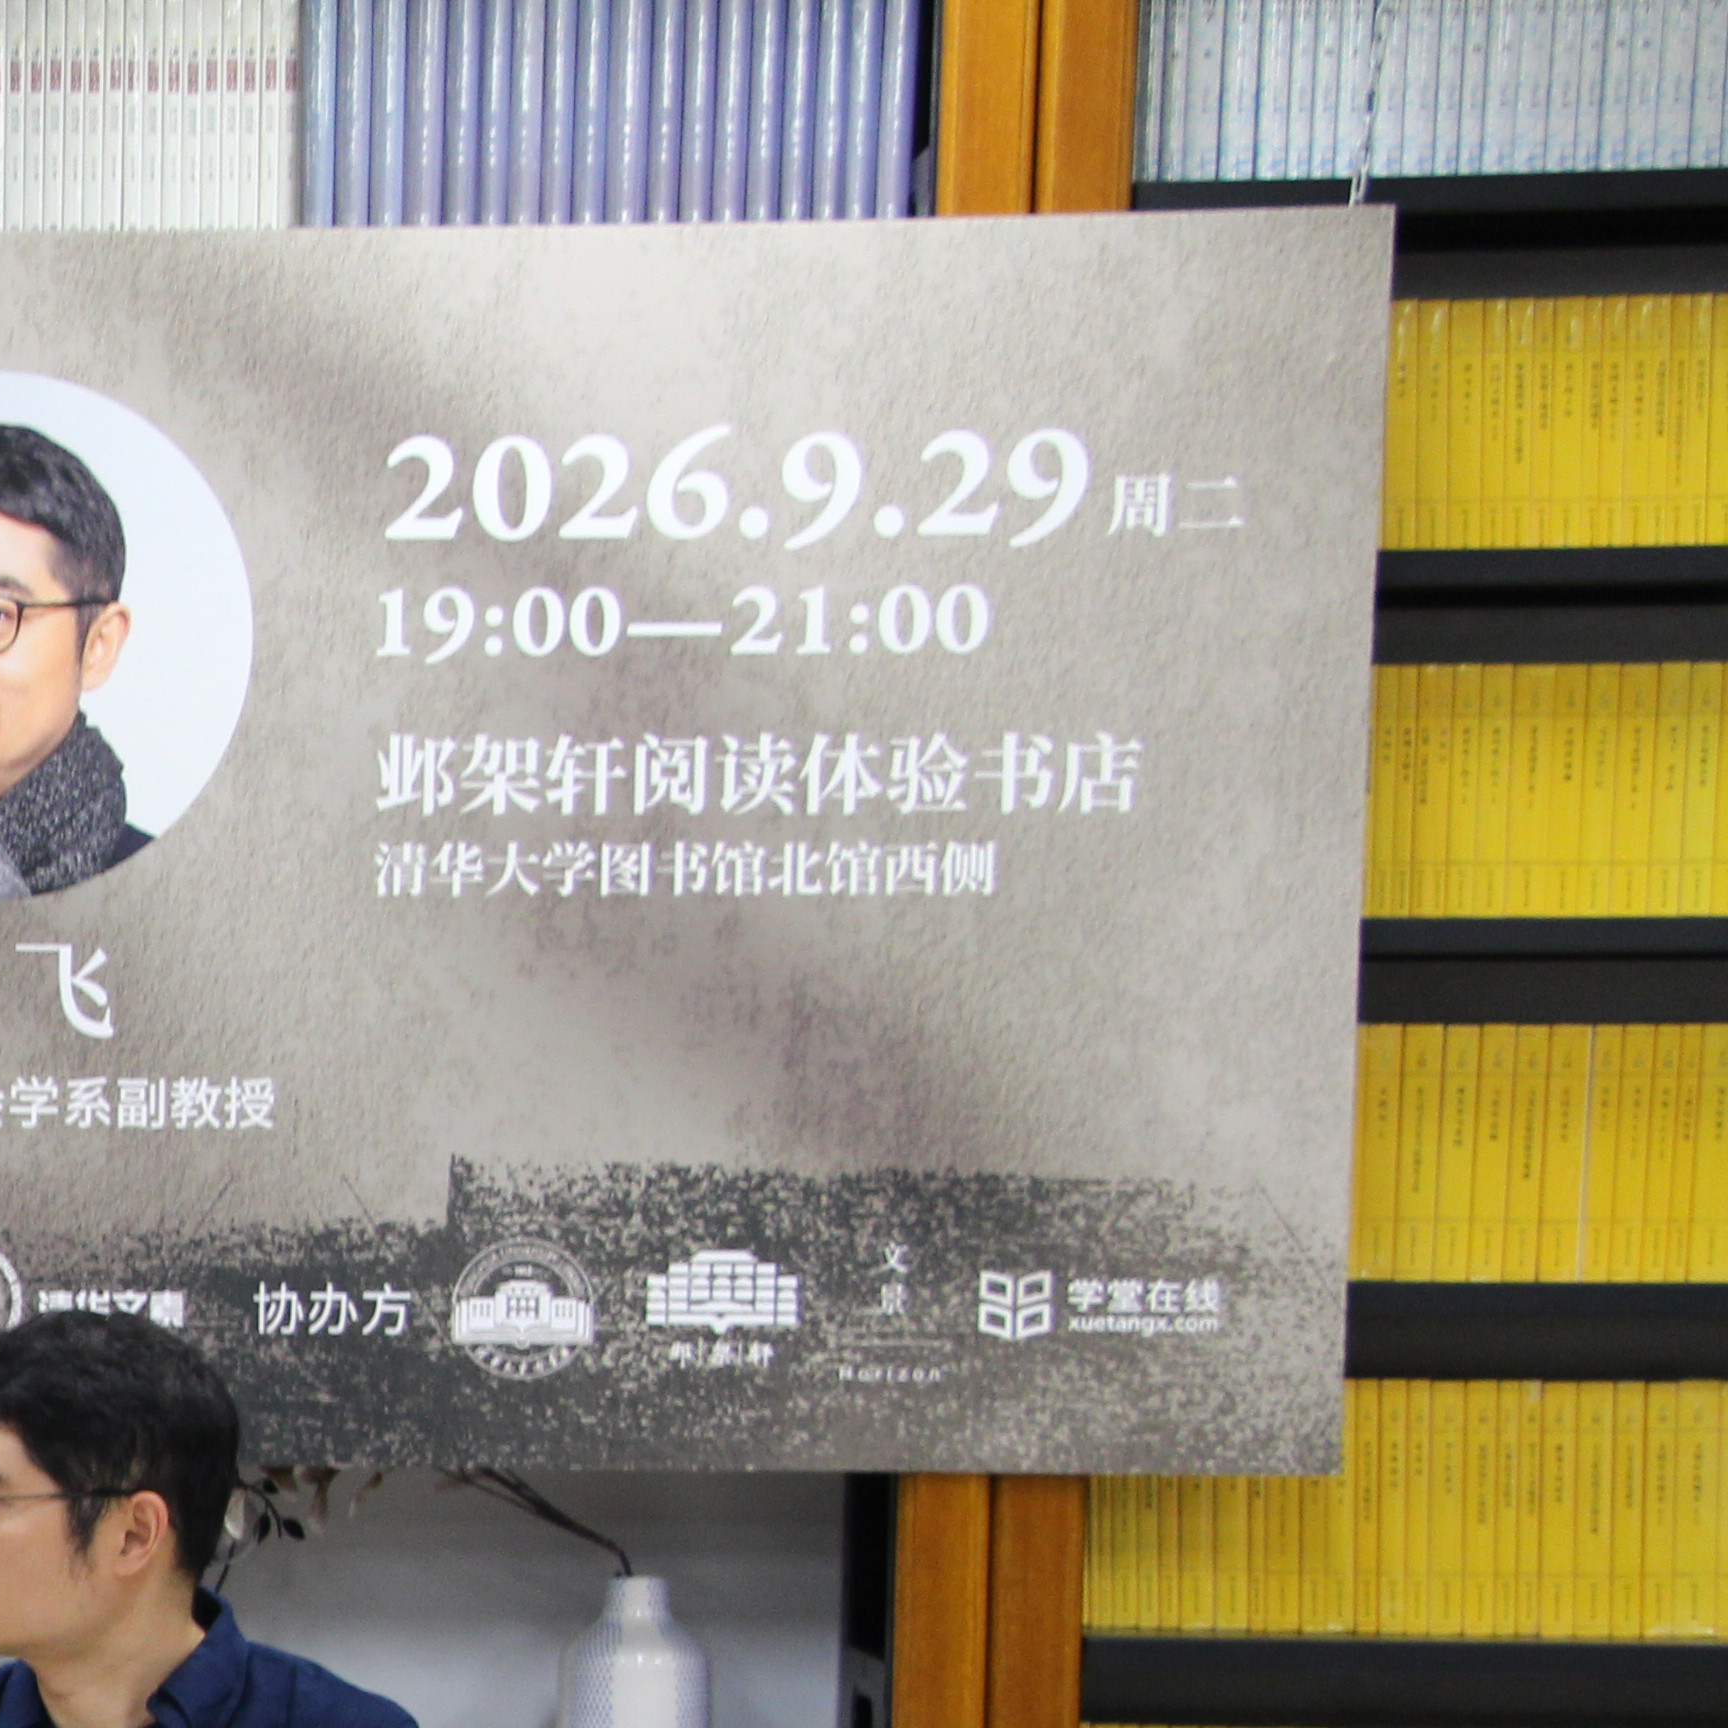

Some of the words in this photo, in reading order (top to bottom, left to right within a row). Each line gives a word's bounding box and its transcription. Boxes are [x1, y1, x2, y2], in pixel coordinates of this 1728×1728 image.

[384, 422, 1091, 550] 2026.9.29
[1107, 471, 1246, 538] 周二
[374, 731, 1144, 817] 邺架轩阅读体验书店
[373, 840, 998, 899] 清华大学图书馆北馆西侧
[252, 1280, 414, 1337] 协办方
[1066, 1277, 1222, 1315] 学堂在线
[1067, 1314, 1222, 1337] xuetangx.com
